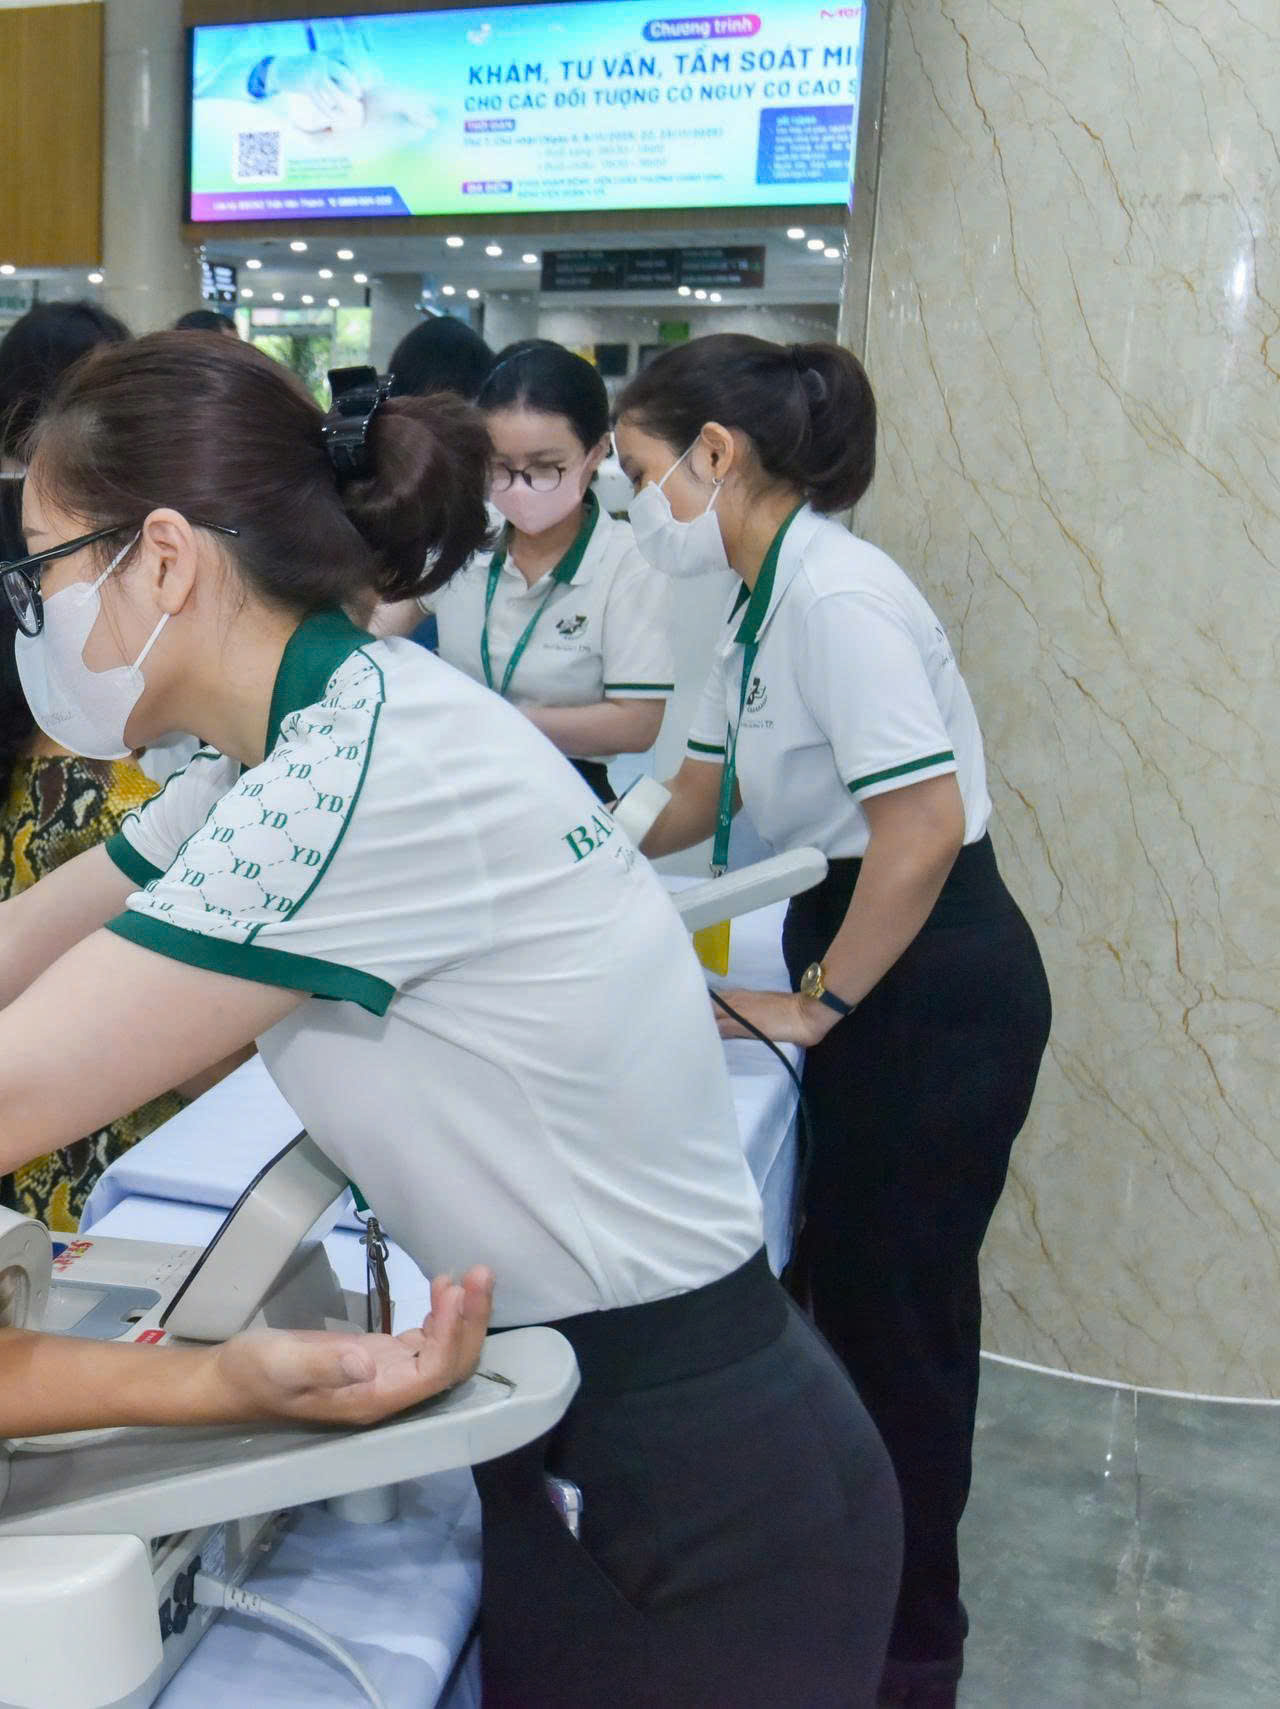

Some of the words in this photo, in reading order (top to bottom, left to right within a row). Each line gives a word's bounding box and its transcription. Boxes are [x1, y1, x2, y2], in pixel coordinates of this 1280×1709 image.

[700, 82, 756, 101] NGUY
[798, 79, 841, 98] CAO
[285, 763, 311, 779] YD
[242, 783, 263, 797] YD
[315, 791, 344, 813] YD
[259, 809, 288, 829] YD
[211, 825, 234, 843] YD
[290, 845, 322, 867] YD
[180, 867, 205, 887] YD
[230, 857, 261, 880] YD
[262, 892, 293, 913] YD
